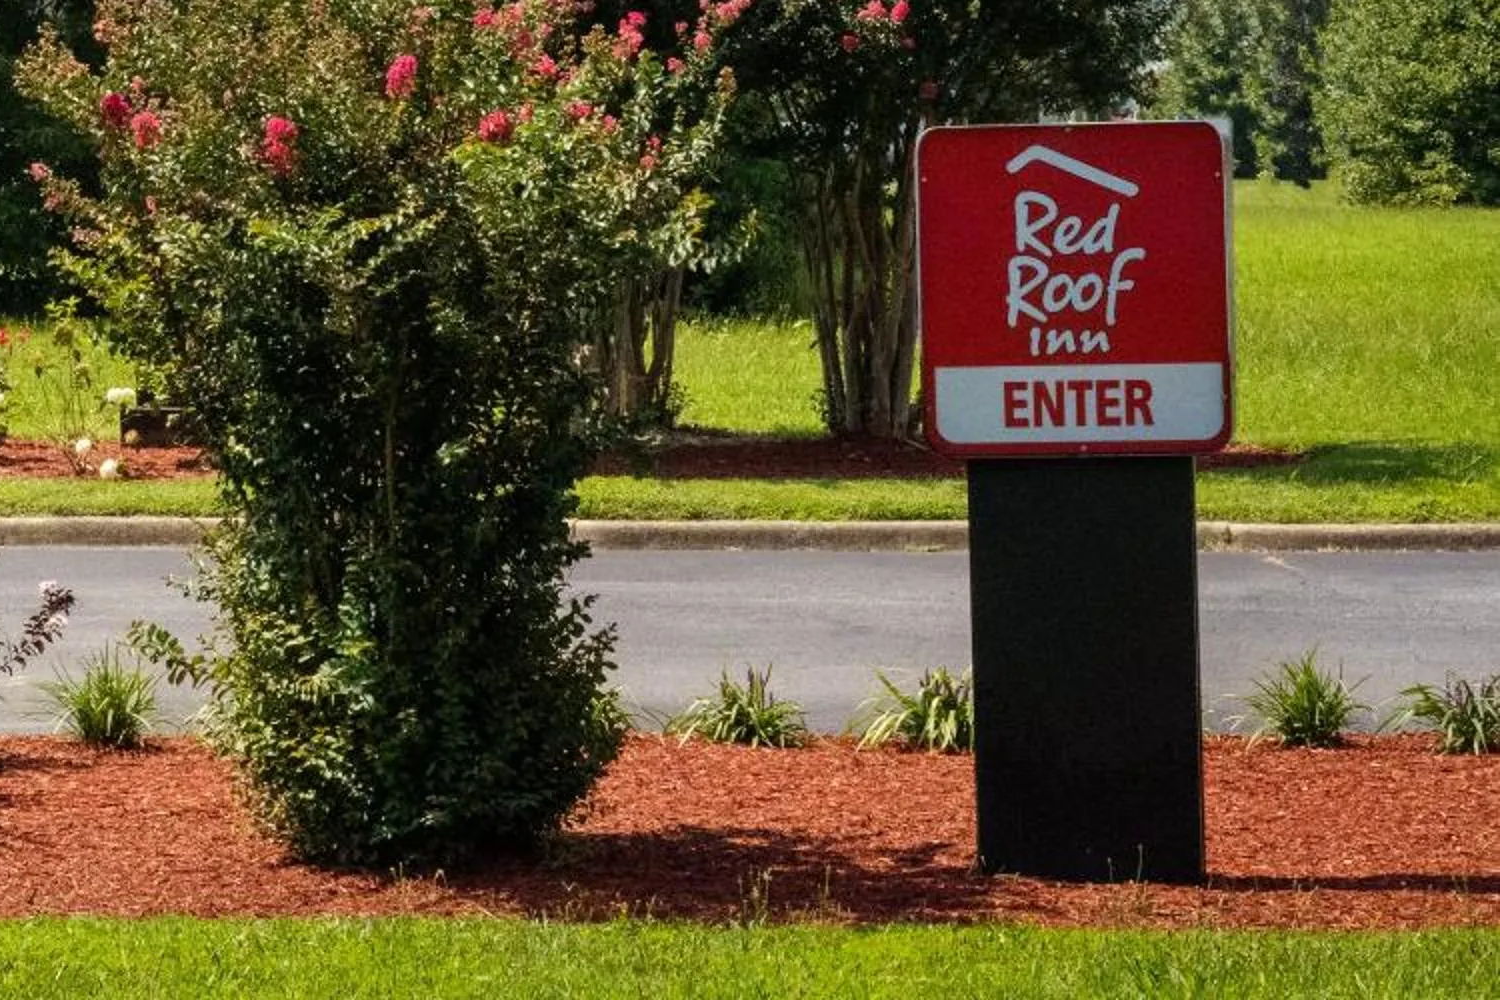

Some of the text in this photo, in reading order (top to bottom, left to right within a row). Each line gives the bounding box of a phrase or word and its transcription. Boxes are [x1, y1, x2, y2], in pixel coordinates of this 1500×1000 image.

[1014, 190, 1121, 257] Red
[1006, 247, 1147, 328] Roof
[1003, 379, 1156, 429] ENTER
